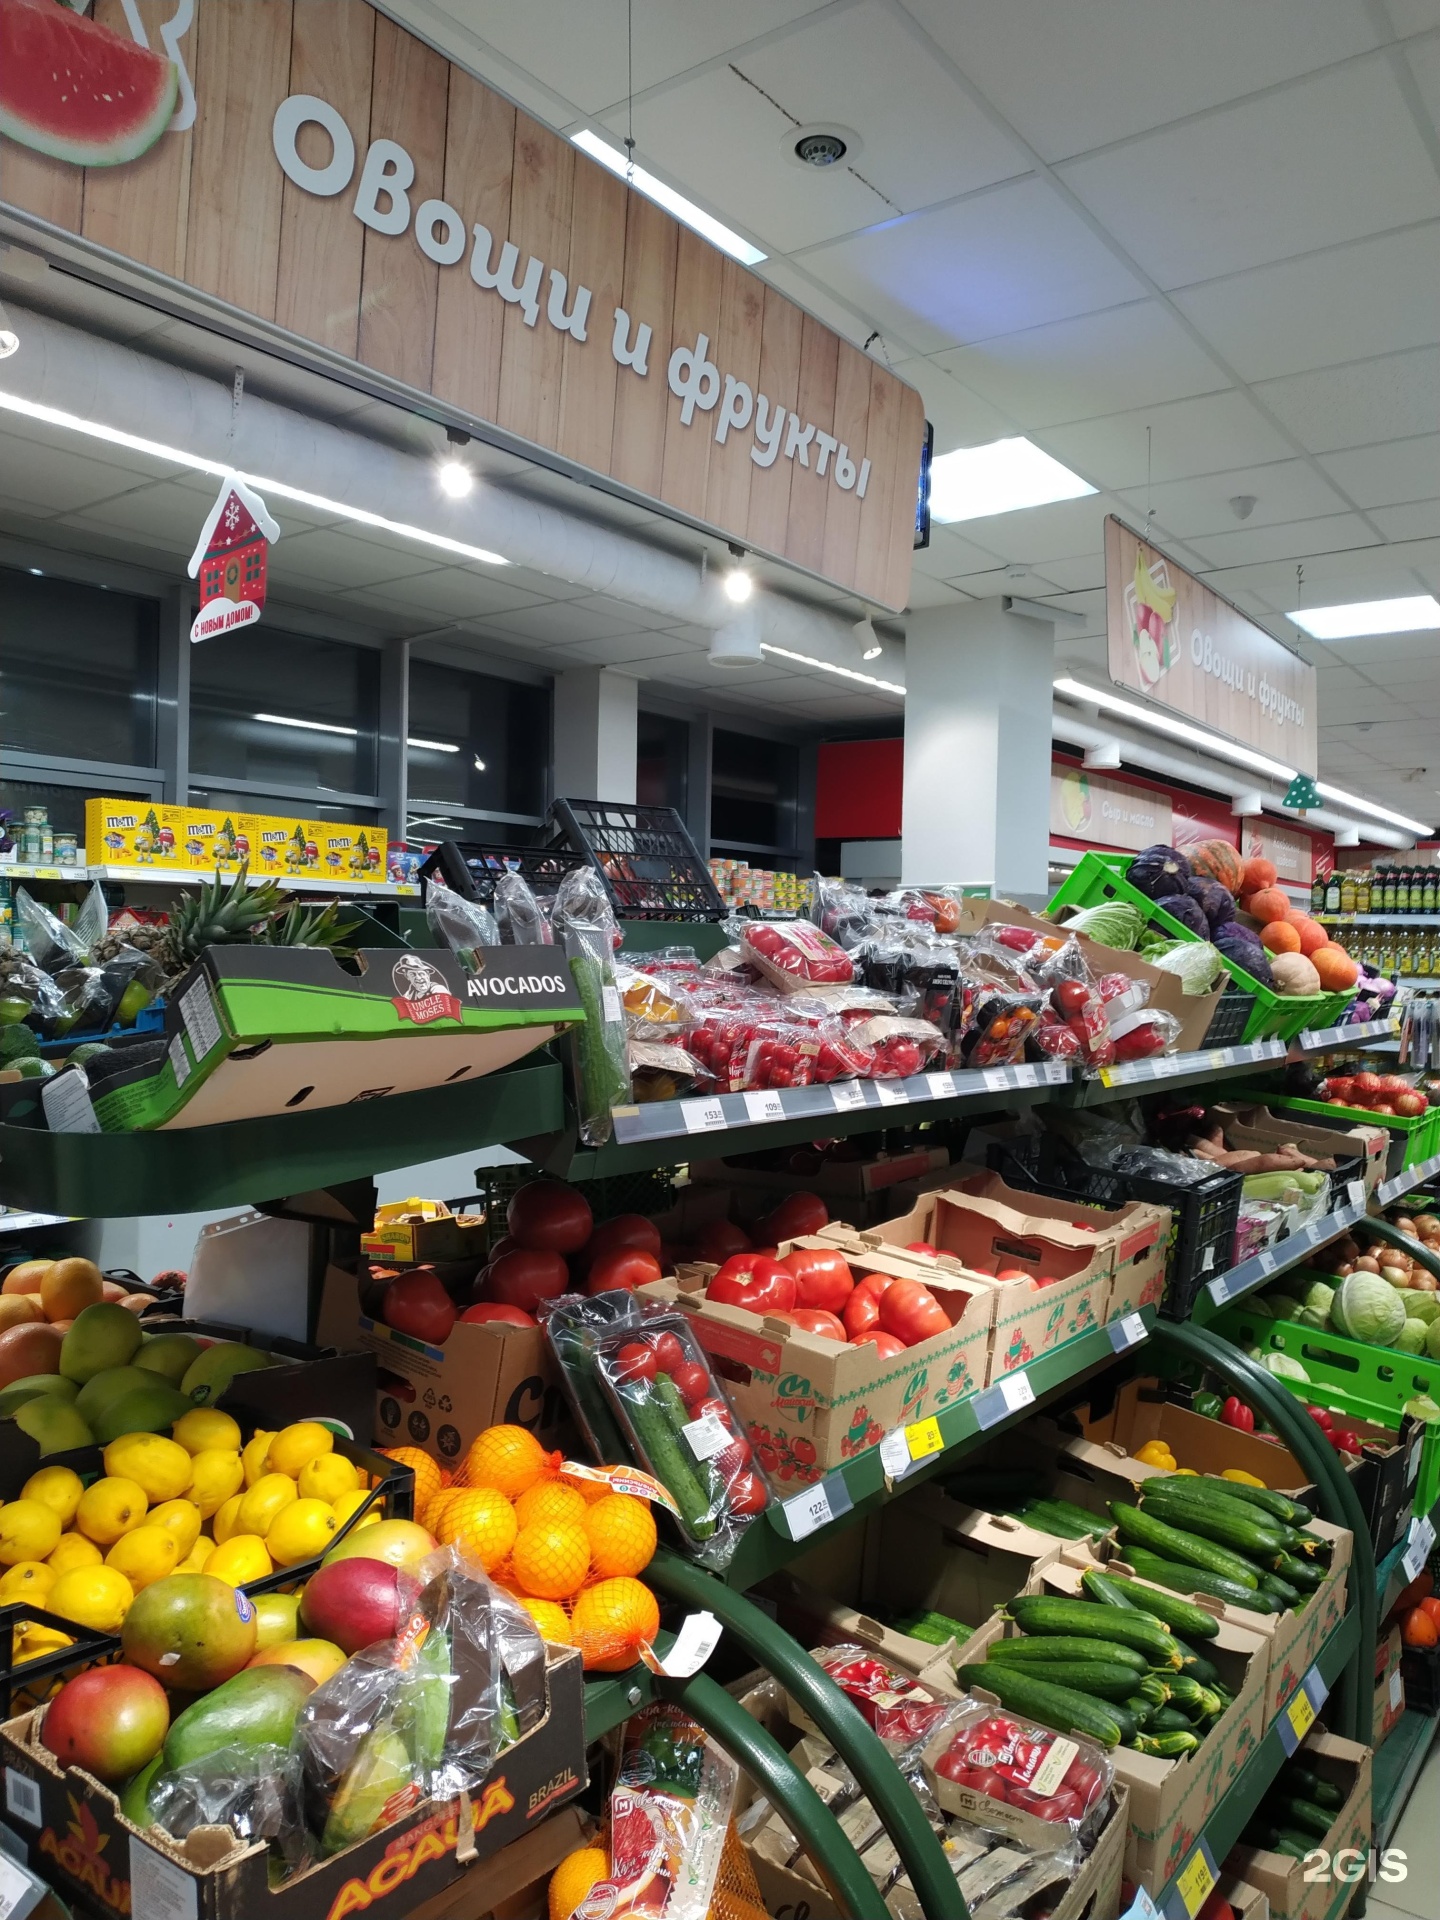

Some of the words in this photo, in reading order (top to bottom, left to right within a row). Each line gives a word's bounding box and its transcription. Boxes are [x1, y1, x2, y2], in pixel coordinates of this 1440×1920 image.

[612, 307, 654, 376] и
[668, 333, 873, 500] фрукты
[195, 624, 199, 638] С
[200, 615, 225, 636] НОВЫМ
[225, 605, 254, 630] ДОМОМ!
[1247, 672, 1256, 700] и
[1259, 672, 1305, 728] фрукты
[466, 975, 567, 997] AVOCADOS
[411, 994, 443, 1012] UNCLE
[415, 1003, 445, 1021] MOSES
[704, 1111, 718, 1120] 153
[381, 1232, 410, 1244] SHARON
[612, 1477, 658, 1494] Апельсины
[809, 1502, 823, 1516] 122
[1012, 1746, 1042, 1784] Томаты
[528, 1767, 577, 1809] BRAZIL
